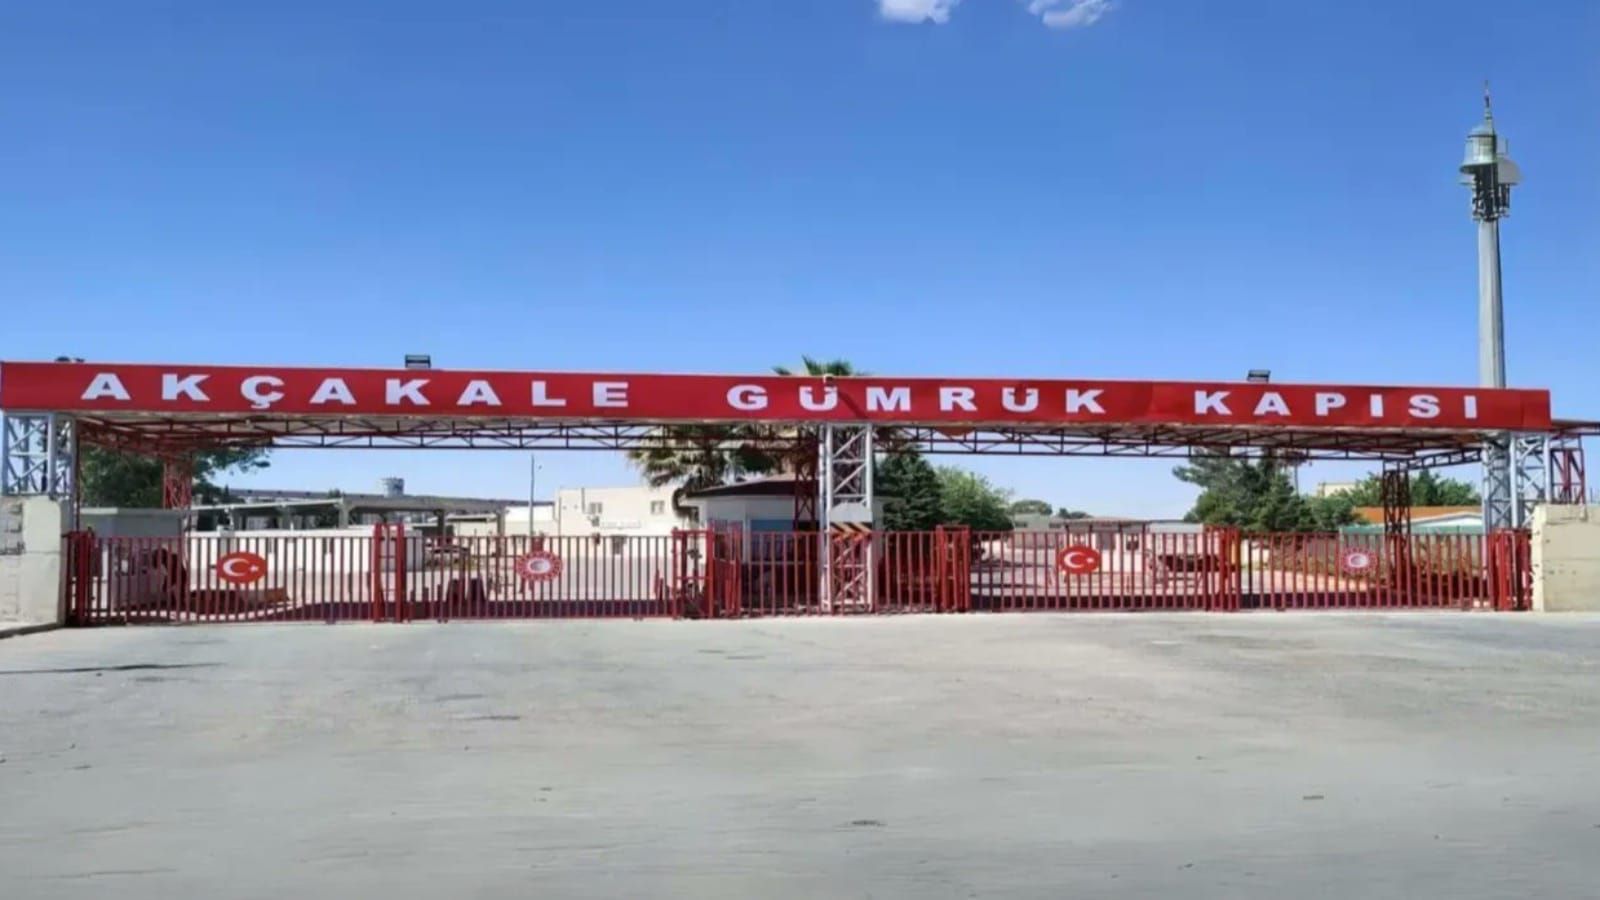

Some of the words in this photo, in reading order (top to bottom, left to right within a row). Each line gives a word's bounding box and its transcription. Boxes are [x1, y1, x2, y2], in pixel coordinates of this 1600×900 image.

[82, 373, 629, 410] AKÇAKALE
[727, 384, 1106, 414] GÜMRÜK
[1194, 391, 1480, 419] KAPISI
